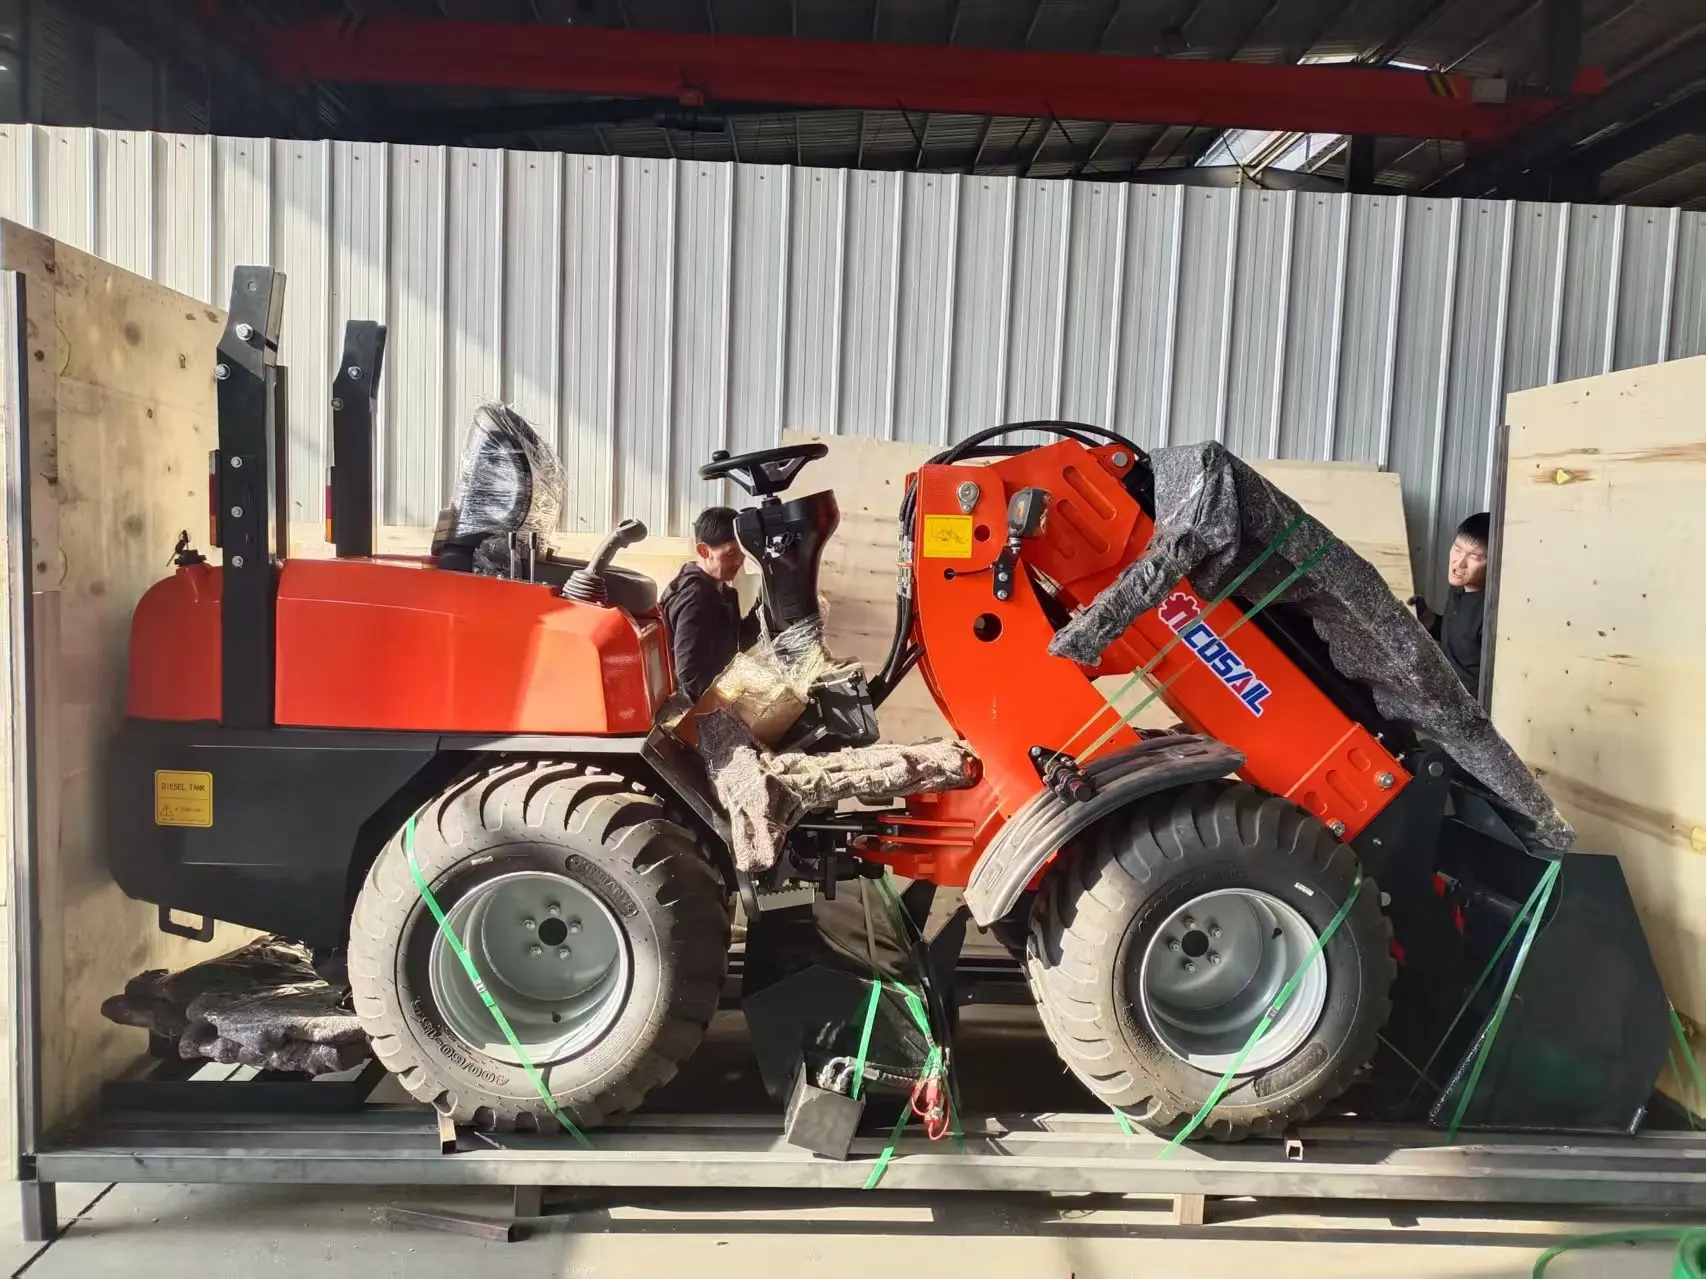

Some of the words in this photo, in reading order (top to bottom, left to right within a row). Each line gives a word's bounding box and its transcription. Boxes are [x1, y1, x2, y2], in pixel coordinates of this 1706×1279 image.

[1183, 623, 1271, 716] COSAIL
[161, 782, 186, 791] DIESEL
[189, 784, 206, 792] TANK
